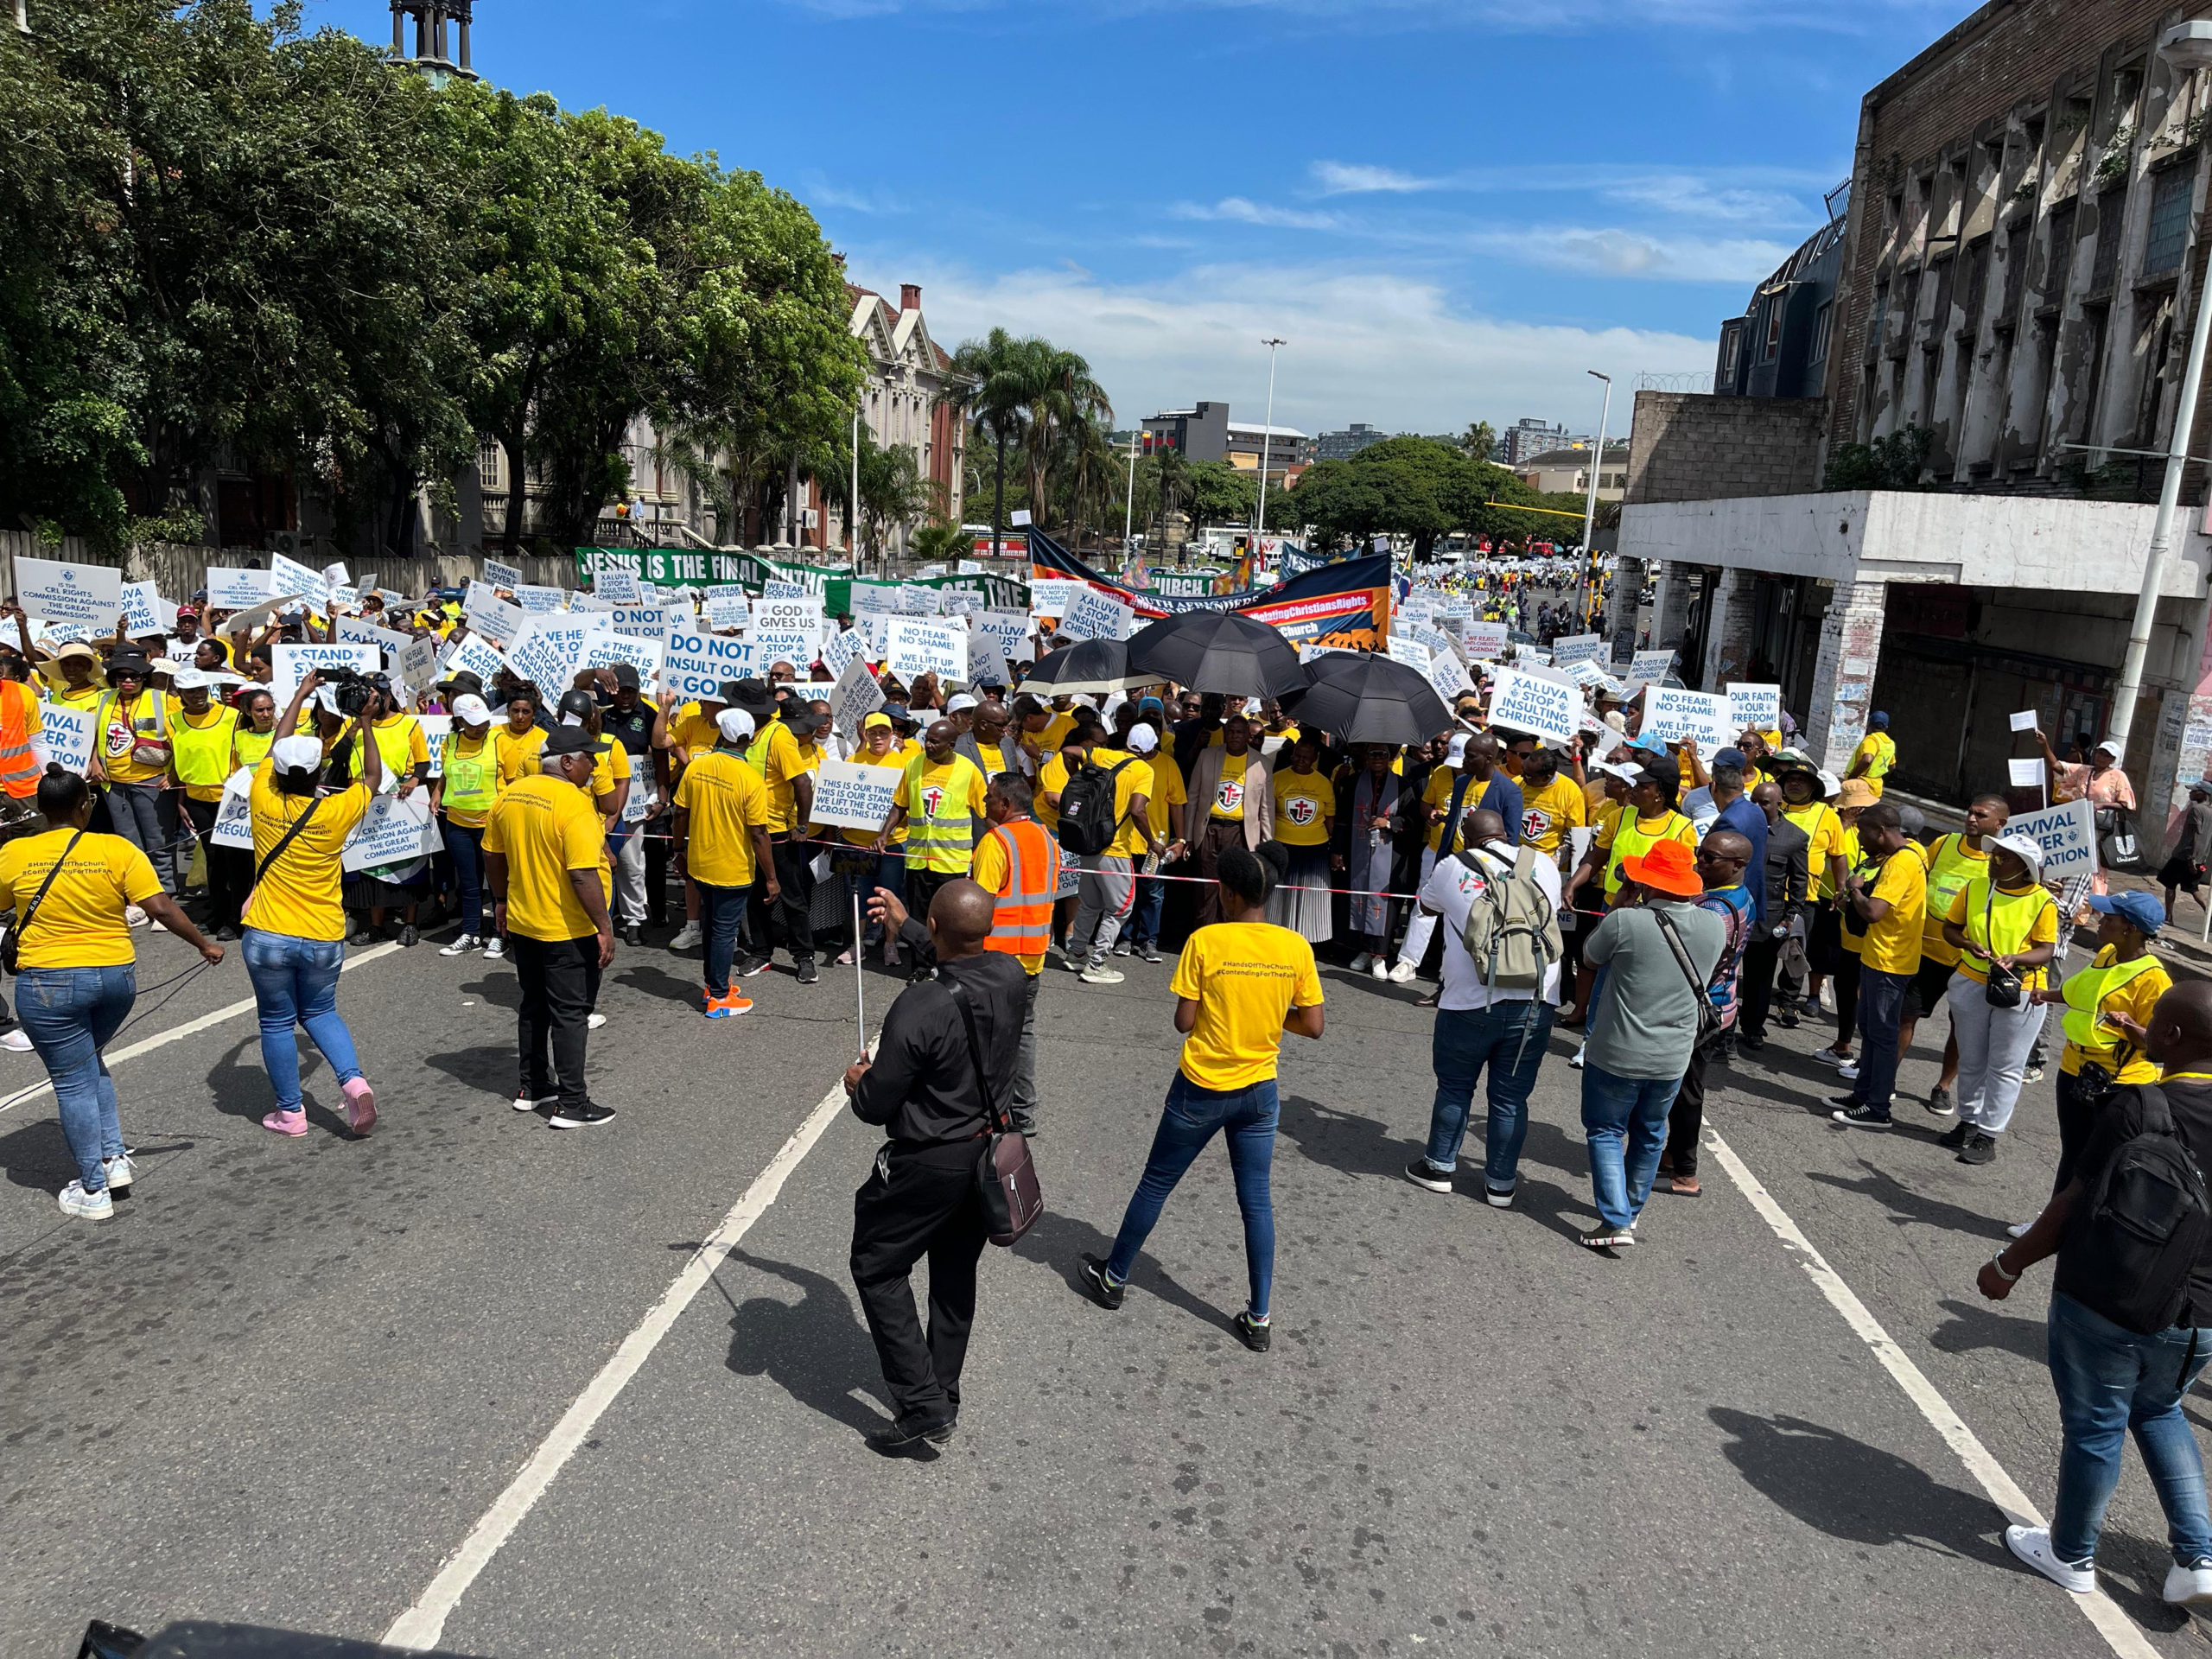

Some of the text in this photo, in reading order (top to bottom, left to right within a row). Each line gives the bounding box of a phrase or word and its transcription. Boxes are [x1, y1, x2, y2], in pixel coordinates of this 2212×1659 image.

[488, 563, 517, 578] REVIVAL
[581, 552, 761, 585] JESUS IS THE FINAL
[492, 573, 511, 583] OVER
[63, 588, 92, 598] RIGHTS
[721, 586, 740, 594] FEAR
[782, 584, 803, 593] FEAR
[984, 577, 1027, 607] THE
[22, 590, 116, 608] COMMISSION AGAINST
[1079, 594, 1120, 617] XALUVA
[41, 607, 99, 620] COMMISSION?
[62, 603, 90, 613] GREAT
[772, 605, 803, 616] GOD
[1085, 607, 1109, 621] STOP
[630, 610, 664, 623] NOT
[760, 617, 815, 628] GIVES US
[756, 634, 804, 643] XALUVA
[904, 626, 950, 640] NO FEAR!
[613, 642, 634, 653] THE
[671, 633, 754, 661] DO NOT
[899, 635, 955, 650] NO SHAME!
[301, 650, 353, 660] STAND
[405, 645, 424, 662] NO FEAR!
[531, 631, 567, 675] XALUVA
[589, 649, 653, 667] CHURCH IS
[900, 652, 918, 661] WE
[919, 656, 938, 664] LIFT
[1555, 647, 1597, 656] ANTI-CHRISTIAN
[1560, 652, 1591, 661] AGENDAS
[405, 654, 429, 672] NO SHAME!
[535, 650, 556, 674] STOP
[975, 653, 990, 665] NOT
[460, 654, 492, 679] MUST
[518, 646, 562, 696] INSULTING
[665, 656, 753, 679] INSULT OUR
[512, 654, 560, 709] CHRISTIANS
[1439, 671, 1455, 692] INSULT
[1443, 664, 1463, 689] DO NOT
[683, 677, 726, 696] GO
[1511, 676, 1568, 701] XALUVA
[1522, 691, 1554, 705] STOP
[1662, 694, 1711, 706] NO FEAR!
[1730, 692, 1750, 702] OUR
[1502, 696, 1569, 723] INSULTING
[1656, 702, 1716, 716] NO SHAME!
[1745, 702, 1764, 712] OUR
[1496, 708, 1571, 736] CHRISTIANS
[1732, 714, 1777, 722] FREEDOM!
[1656, 721, 1674, 729] WE
[1676, 722, 1697, 732] LIFT
[634, 762, 644, 771] NO
[631, 773, 640, 782] NO
[817, 787, 835, 796] THIS
[823, 779, 842, 788] THIS
[853, 784, 872, 792] OUR
[631, 796, 641, 804] WE
[831, 798, 848, 806] LIFT
[849, 800, 864, 809] THE
[814, 804, 869, 818] ACROSS THIS
[378, 820, 407, 832] RIGHTS
[397, 823, 431, 836] AGAINST
[385, 836, 410, 847] GREAT
[365, 842, 419, 860] COMMISSION?
[2116, 855, 2139, 864] Unilever
[1223, 961, 1294, 969] #HandsOffTheChurch
[1217, 969, 1297, 978] #ContendingForTheFaith
